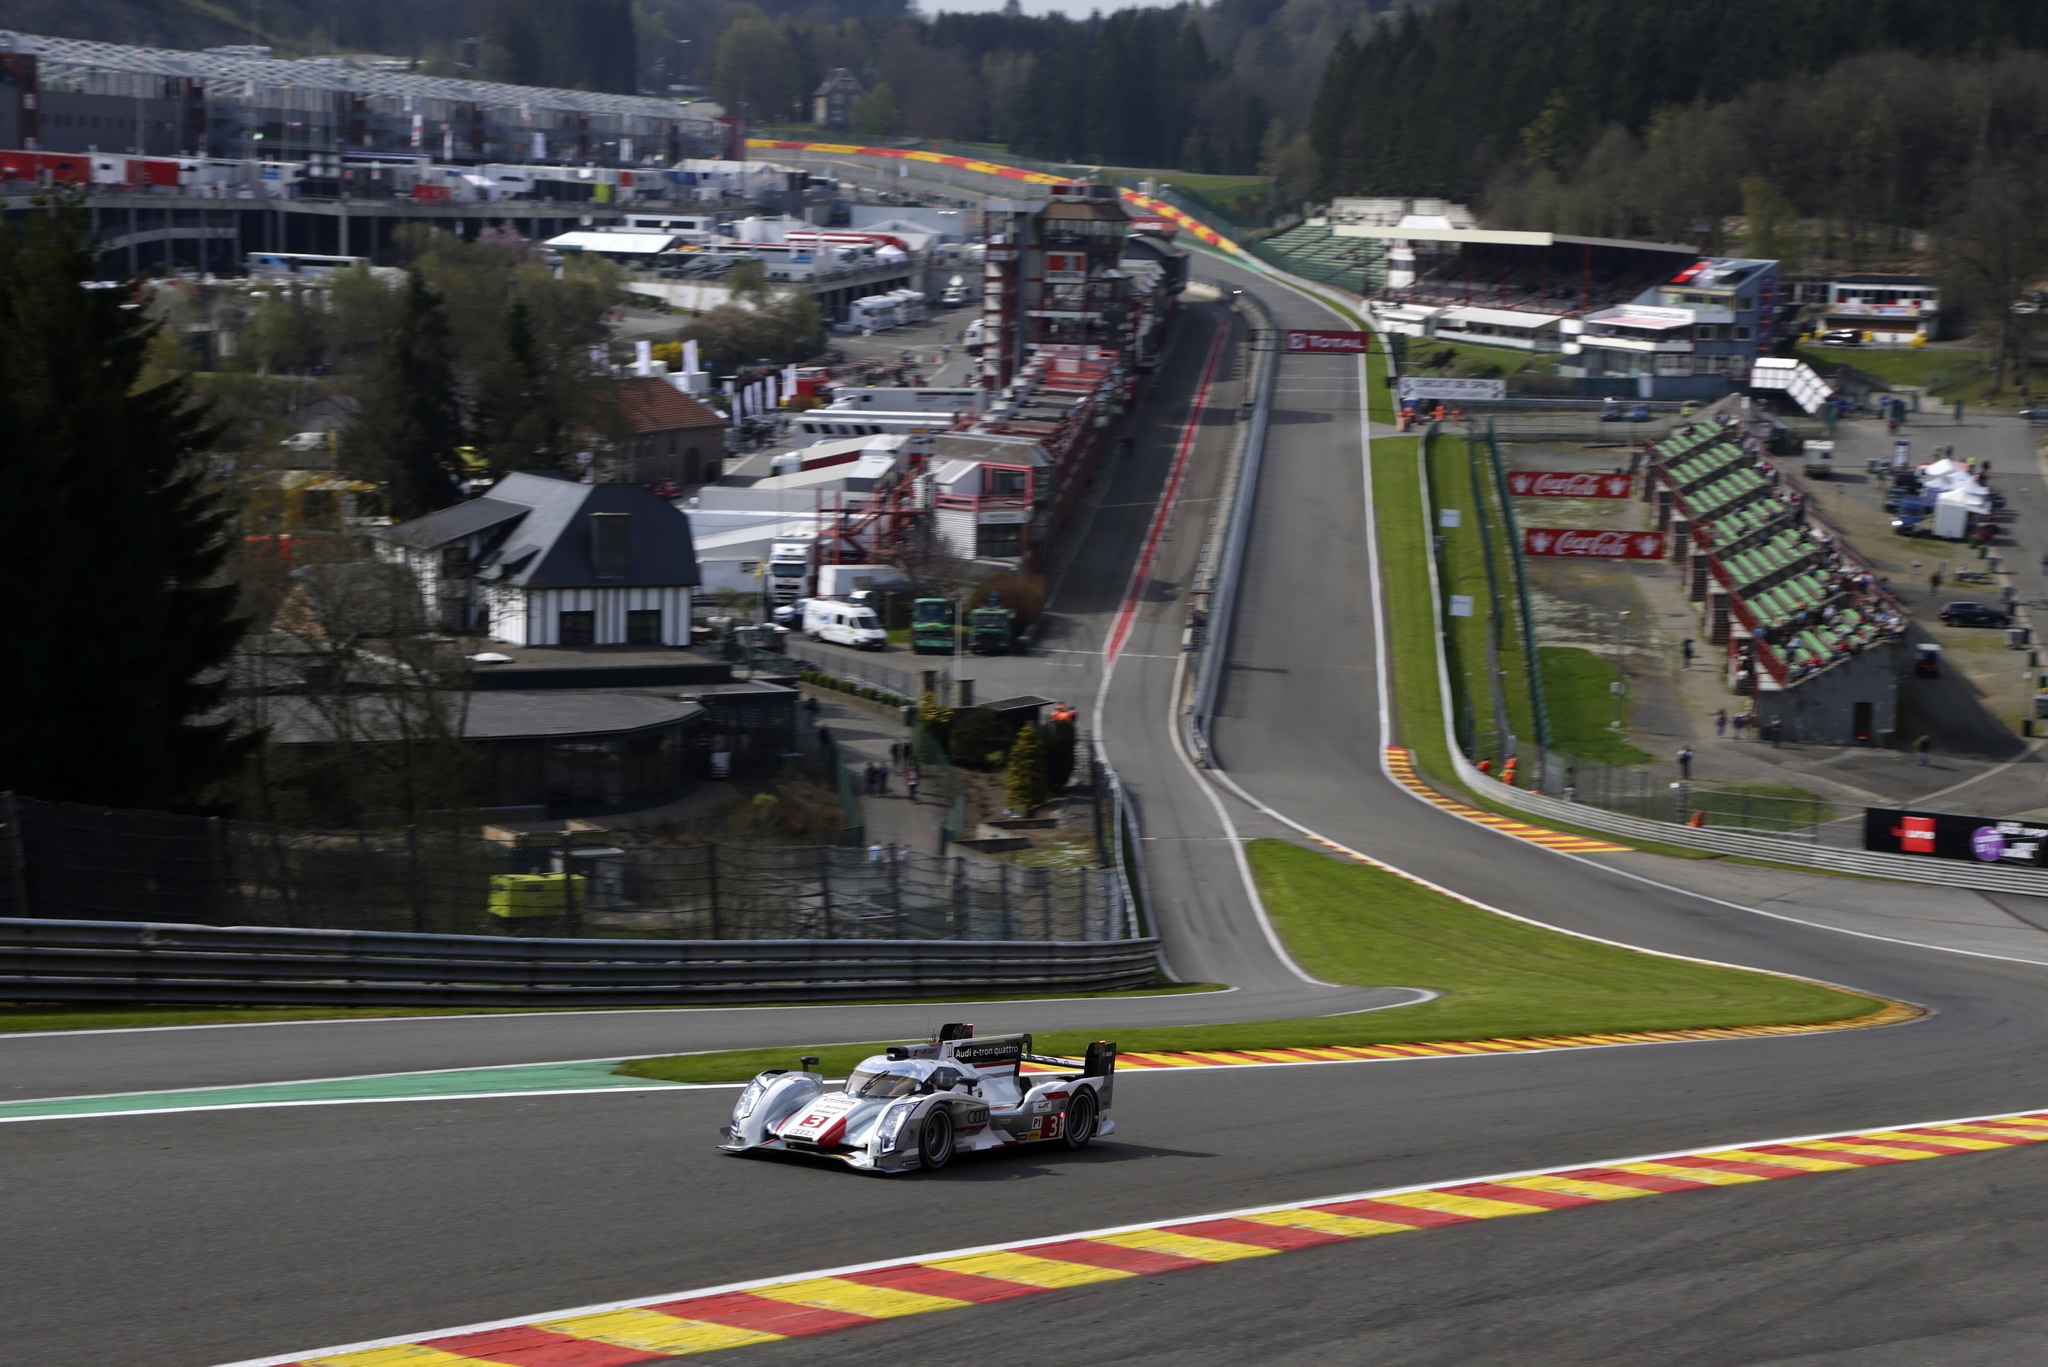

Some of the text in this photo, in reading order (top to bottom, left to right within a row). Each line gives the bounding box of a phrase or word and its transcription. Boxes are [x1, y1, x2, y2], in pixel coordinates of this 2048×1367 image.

[955, 1045, 1019, 1058] Audi e-tron quattro
[802, 1115, 826, 1128] 3
[1032, 1117, 1042, 1129] P1
[1048, 1115, 1059, 1137] 3
